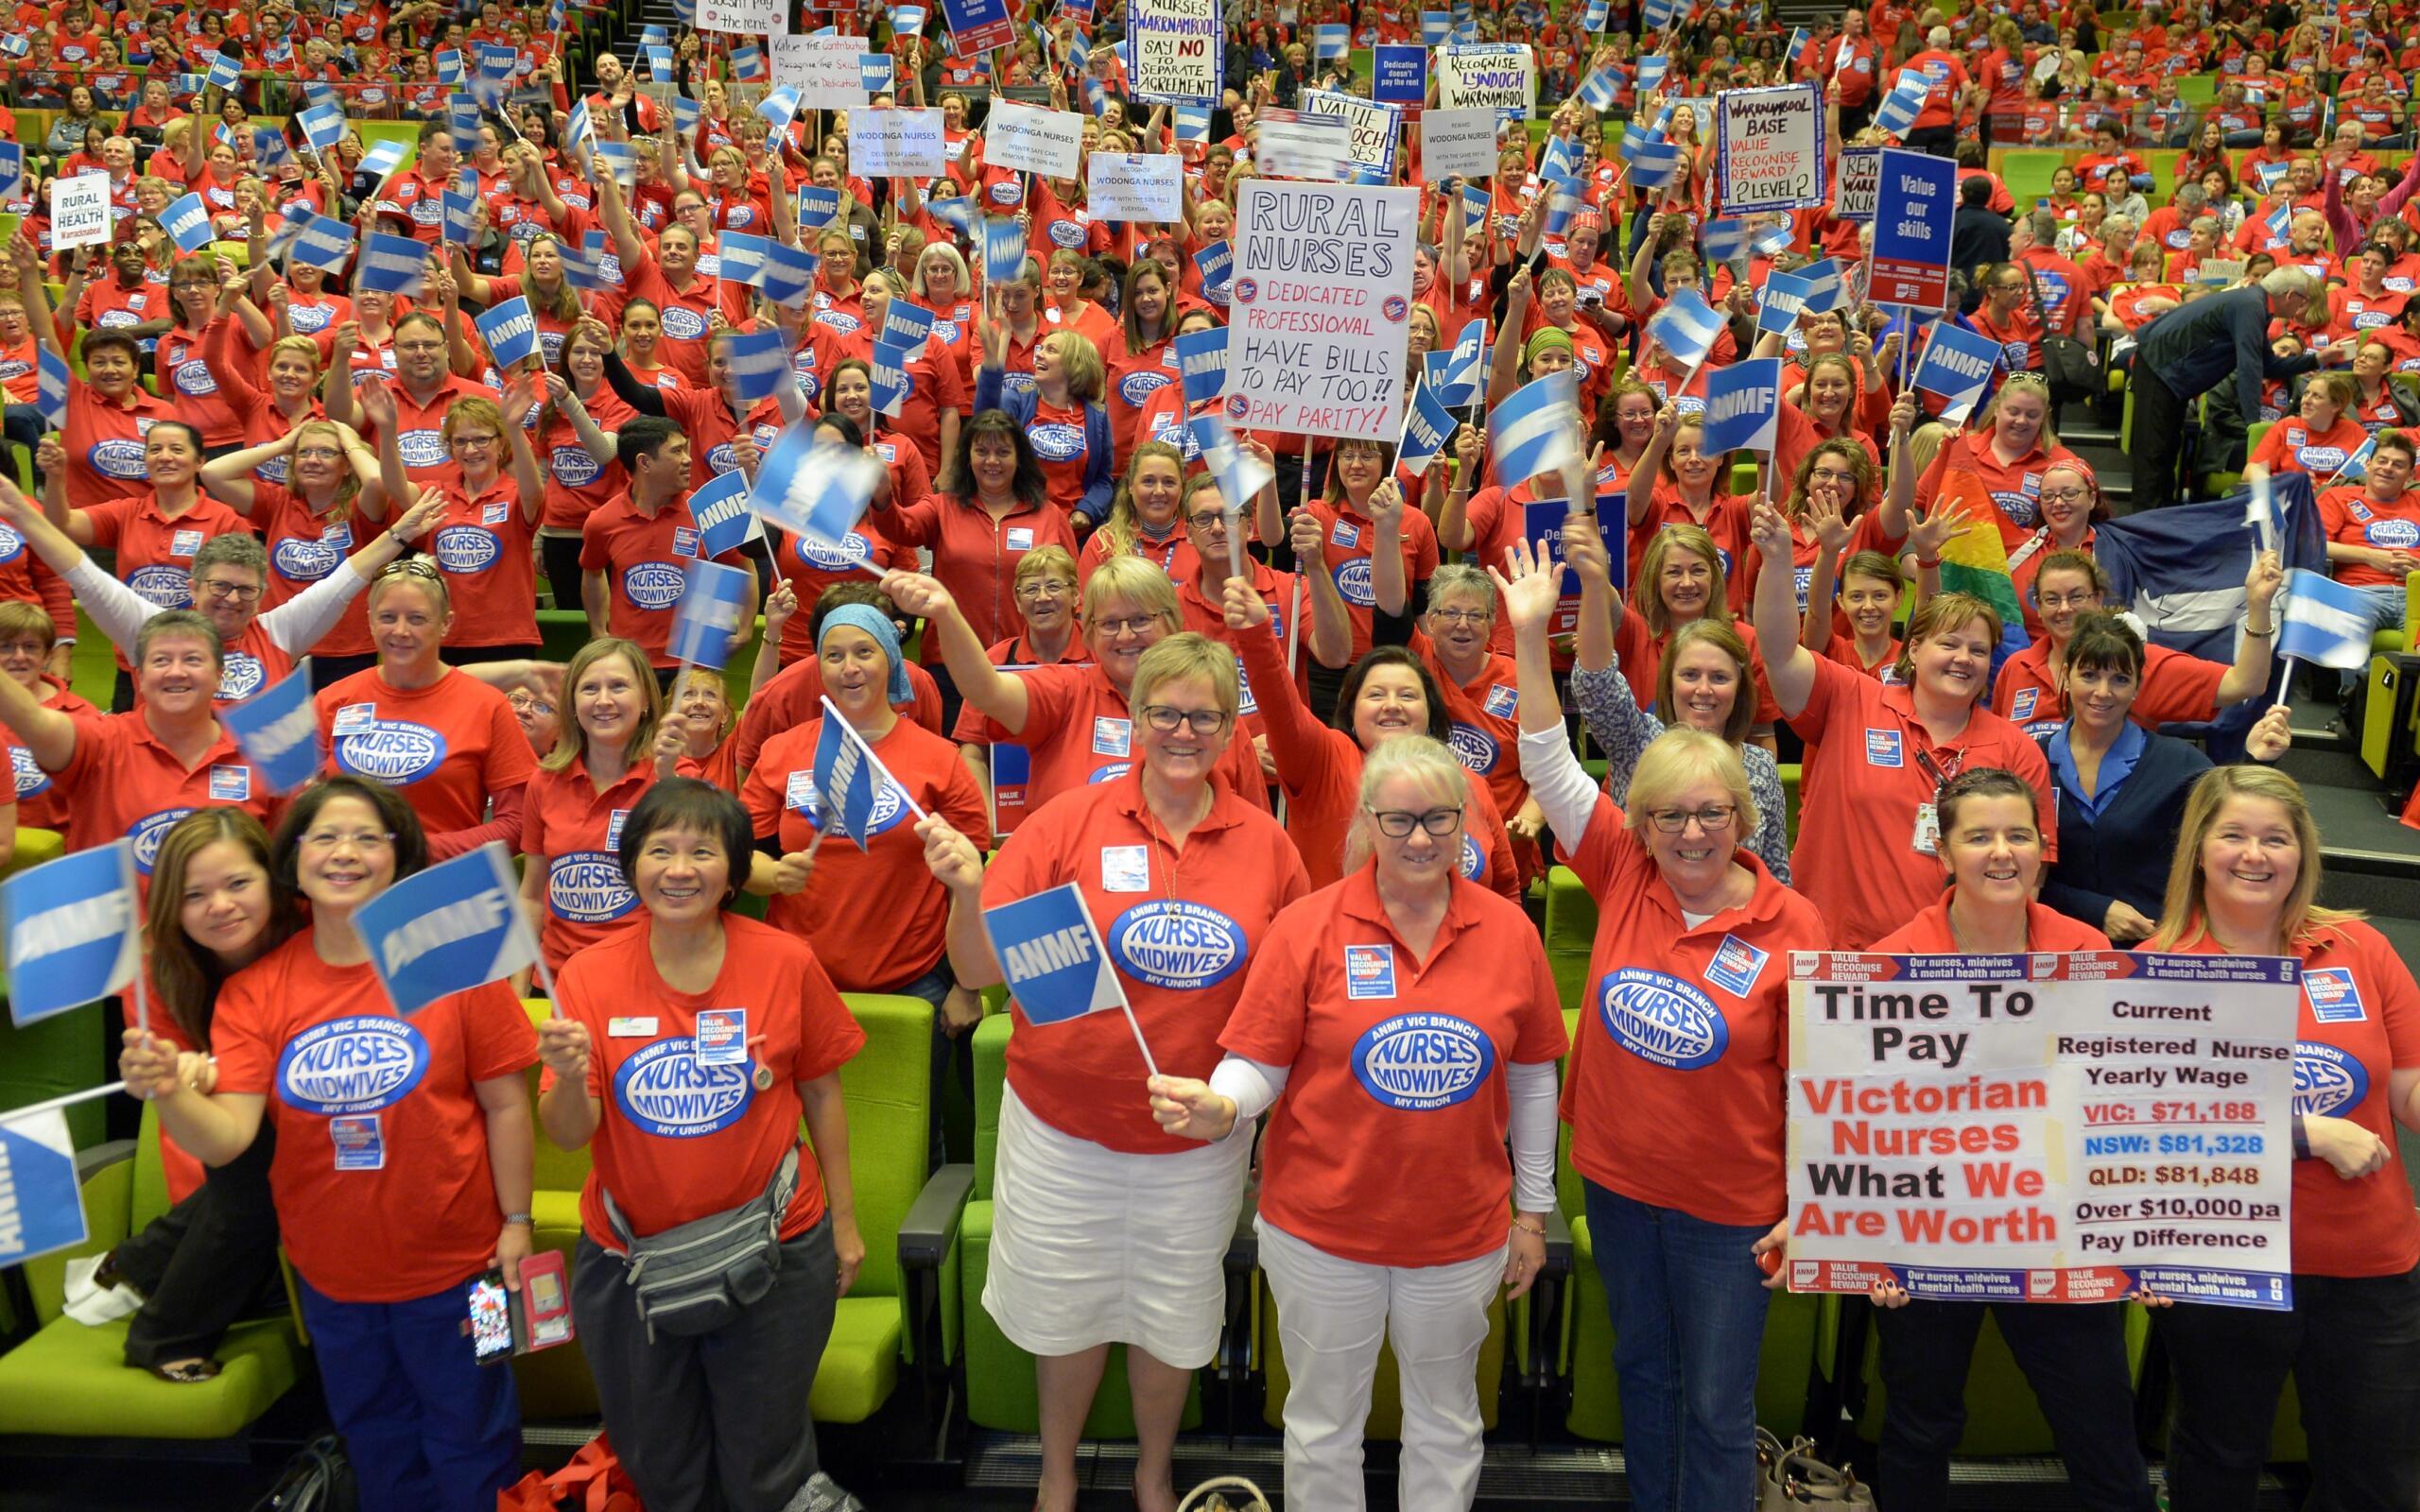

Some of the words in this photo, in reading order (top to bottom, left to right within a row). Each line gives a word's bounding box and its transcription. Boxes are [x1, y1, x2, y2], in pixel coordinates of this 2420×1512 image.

[1152, 0, 1207, 16] NURSES
[720, 13, 741, 28] the
[743, 17, 768, 29] rent
[1135, 8, 1215, 38] WARRNAMBOOL
[773, 39, 801, 53] Value
[805, 41, 821, 50] THE
[822, 40, 869, 51] Contribution
[1145, 40, 1173, 55] SAY
[1178, 39, 1204, 57] NO
[212, 62, 237, 80] ANMF
[438, 60, 460, 73] ANMF
[483, 56, 515, 69] ANMF
[861, 65, 890, 78] ANMF
[1140, 62, 1204, 76] SEPARATE
[1383, 60, 1418, 69] Dedication
[1451, 56, 1518, 76] RECOGNISE
[821, 77, 861, 88] Dedication
[1138, 77, 1215, 95] AGREEMENT
[1463, 70, 1525, 90] LYNDOCH
[1452, 89, 1527, 108] WARRNAMBOOL
[856, 131, 903, 140] WODONGA
[904, 131, 937, 140] NURSES
[997, 123, 1042, 137] WODONGA
[1044, 131, 1074, 144] NURSES
[1429, 134, 1466, 143] WODONGA
[1468, 131, 1491, 140] NURSES
[1746, 118, 1788, 137] BASE
[1730, 137, 1770, 153] VALUE
[1731, 150, 1800, 167] RECOGNISE
[1097, 177, 1141, 185] WODONGA
[1752, 180, 1794, 199] LEVEL
[1901, 175, 1936, 197] Value
[61, 193, 100, 208] RURAL
[802, 198, 837, 214] ANMF
[1906, 201, 1928, 217] our
[58, 211, 103, 228] HEALTH
[170, 206, 205, 236] ANMF
[1251, 191, 1399, 238] RURAL
[1897, 220, 1932, 240] skills
[1247, 235, 1393, 278] NURSES
[1267, 280, 1369, 307] DEDICATED
[488, 314, 533, 348] ANMF
[887, 314, 929, 338] ANMF
[1248, 308, 1374, 336] PROFESSIONAL
[1245, 336, 1313, 368] HAVE
[1325, 345, 1390, 375] BILLS
[1927, 343, 1991, 379] ANMF
[1241, 367, 1264, 389] TO
[1273, 369, 1312, 397] PAY
[1320, 374, 1393, 403] TOO!!
[1249, 400, 1288, 425] PAY
[1297, 404, 1389, 434] PARITY!
[698, 491, 749, 534] ANMF
[2374, 534, 2417, 545] MIDWIVES
[2375, 523, 2415, 535] NURSES
[441, 535, 492, 551] NURSES
[439, 552, 491, 566] MIDWIVES
[348, 732, 431, 753] NURSES
[347, 749, 428, 774] MIDWIVES
[829, 728, 860, 818] ANMF
[553, 866, 627, 888] NURSES
[553, 890, 630, 910] MIDWIVES
[1130, 902, 1160, 921] ANMF
[1163, 902, 1182, 914] VIC
[1184, 903, 1232, 929] BRANCH
[1131, 918, 1231, 951] NURSES
[1004, 923, 1093, 984] ANMF
[1129, 945, 1228, 975] MIDWIVES
[1350, 954, 1373, 962] VALUE
[1831, 954, 1859, 963] VALUE
[1910, 957, 1928, 967] Our
[1931, 958, 1964, 969] nurses,
[1967, 957, 2013, 967] midwives
[1350, 960, 1390, 969] RECOGNISE
[1351, 968, 1381, 976] REWARD
[1831, 963, 1882, 972] RECOGNISE
[1910, 969, 1918, 978] &
[1920, 969, 1954, 978] mental
[1956, 968, 1987, 978] health
[1990, 969, 2022, 978] nurses
[1145, 973, 1162, 985] MY
[1165, 978, 1201, 988] UNION
[1831, 972, 1870, 981] REWARD
[1619, 971, 1653, 982] ANMF
[1656, 975, 1673, 988] VIC
[1675, 985, 1718, 1019] BRANCH
[1815, 986, 1949, 1020] Time
[1969, 985, 2033, 1018] To
[1613, 984, 1709, 1040] NURSES
[2113, 1001, 2212, 1022] Current
[700, 1019, 724, 1027] VALUE
[700, 1025, 742, 1034] RECOGNISE
[1372, 1019, 1405, 1041] ANMF
[1407, 1016, 1426, 1027] VIC
[1430, 1017, 1479, 1040] BRANCH
[1610, 1004, 1705, 1056] MIDWIVES
[293, 1026, 330, 1051] ANMF
[332, 1020, 354, 1032] VIC
[357, 1019, 411, 1038] BRANCH
[700, 1033, 734, 1042] REWARD
[296, 1036, 407, 1074] NURSES
[633, 1043, 667, 1068] ANMF
[669, 1040, 691, 1052] VIC
[1374, 1033, 1478, 1064] NURSES
[1622, 1039, 1639, 1052] MY
[1641, 1048, 1677, 1067] UNION
[1873, 1026, 1968, 1068] Pay
[2058, 1038, 2196, 1057] Registered
[2211, 1041, 2290, 1060] Nurse
[295, 1065, 406, 1099] MIDWIVES
[634, 1057, 741, 1091] NURSES
[1374, 1066, 1476, 1093] MIDWIVES
[2086, 1068, 2167, 1088] Yearly
[2175, 1067, 2248, 1088] Wage
[322, 1105, 342, 1113] MY
[345, 1098, 386, 1112] UNION
[633, 1089, 741, 1120] MIDWIVES
[1394, 1096, 1412, 1108] MY
[1415, 1095, 1451, 1108] UNION
[1801, 1075, 2048, 1115] Victorian
[2083, 1104, 2135, 1123] VIC:
[2152, 1102, 2256, 1123] $71,188
[657, 1125, 677, 1136] MY
[679, 1122, 718, 1135] UNION
[1833, 1121, 2019, 1156] Nurses
[2086, 1135, 2151, 1156] NSW:
[2158, 1134, 2264, 1156] $81,328
[1807, 1163, 1945, 1198] What
[1962, 1162, 2044, 1198] We
[2089, 1167, 2146, 1186] QLD:
[2155, 1166, 2259, 1187] $81,848
[2076, 1202, 2133, 1220] Over
[2140, 1198, 2242, 1218] $10,000
[2249, 1204, 2280, 1221] pa
[1794, 1202, 1886, 1236] Are
[1896, 1207, 2056, 1244] Worth
[2082, 1233, 2125, 1252] Pay
[2134, 1229, 2268, 1248] Difference
